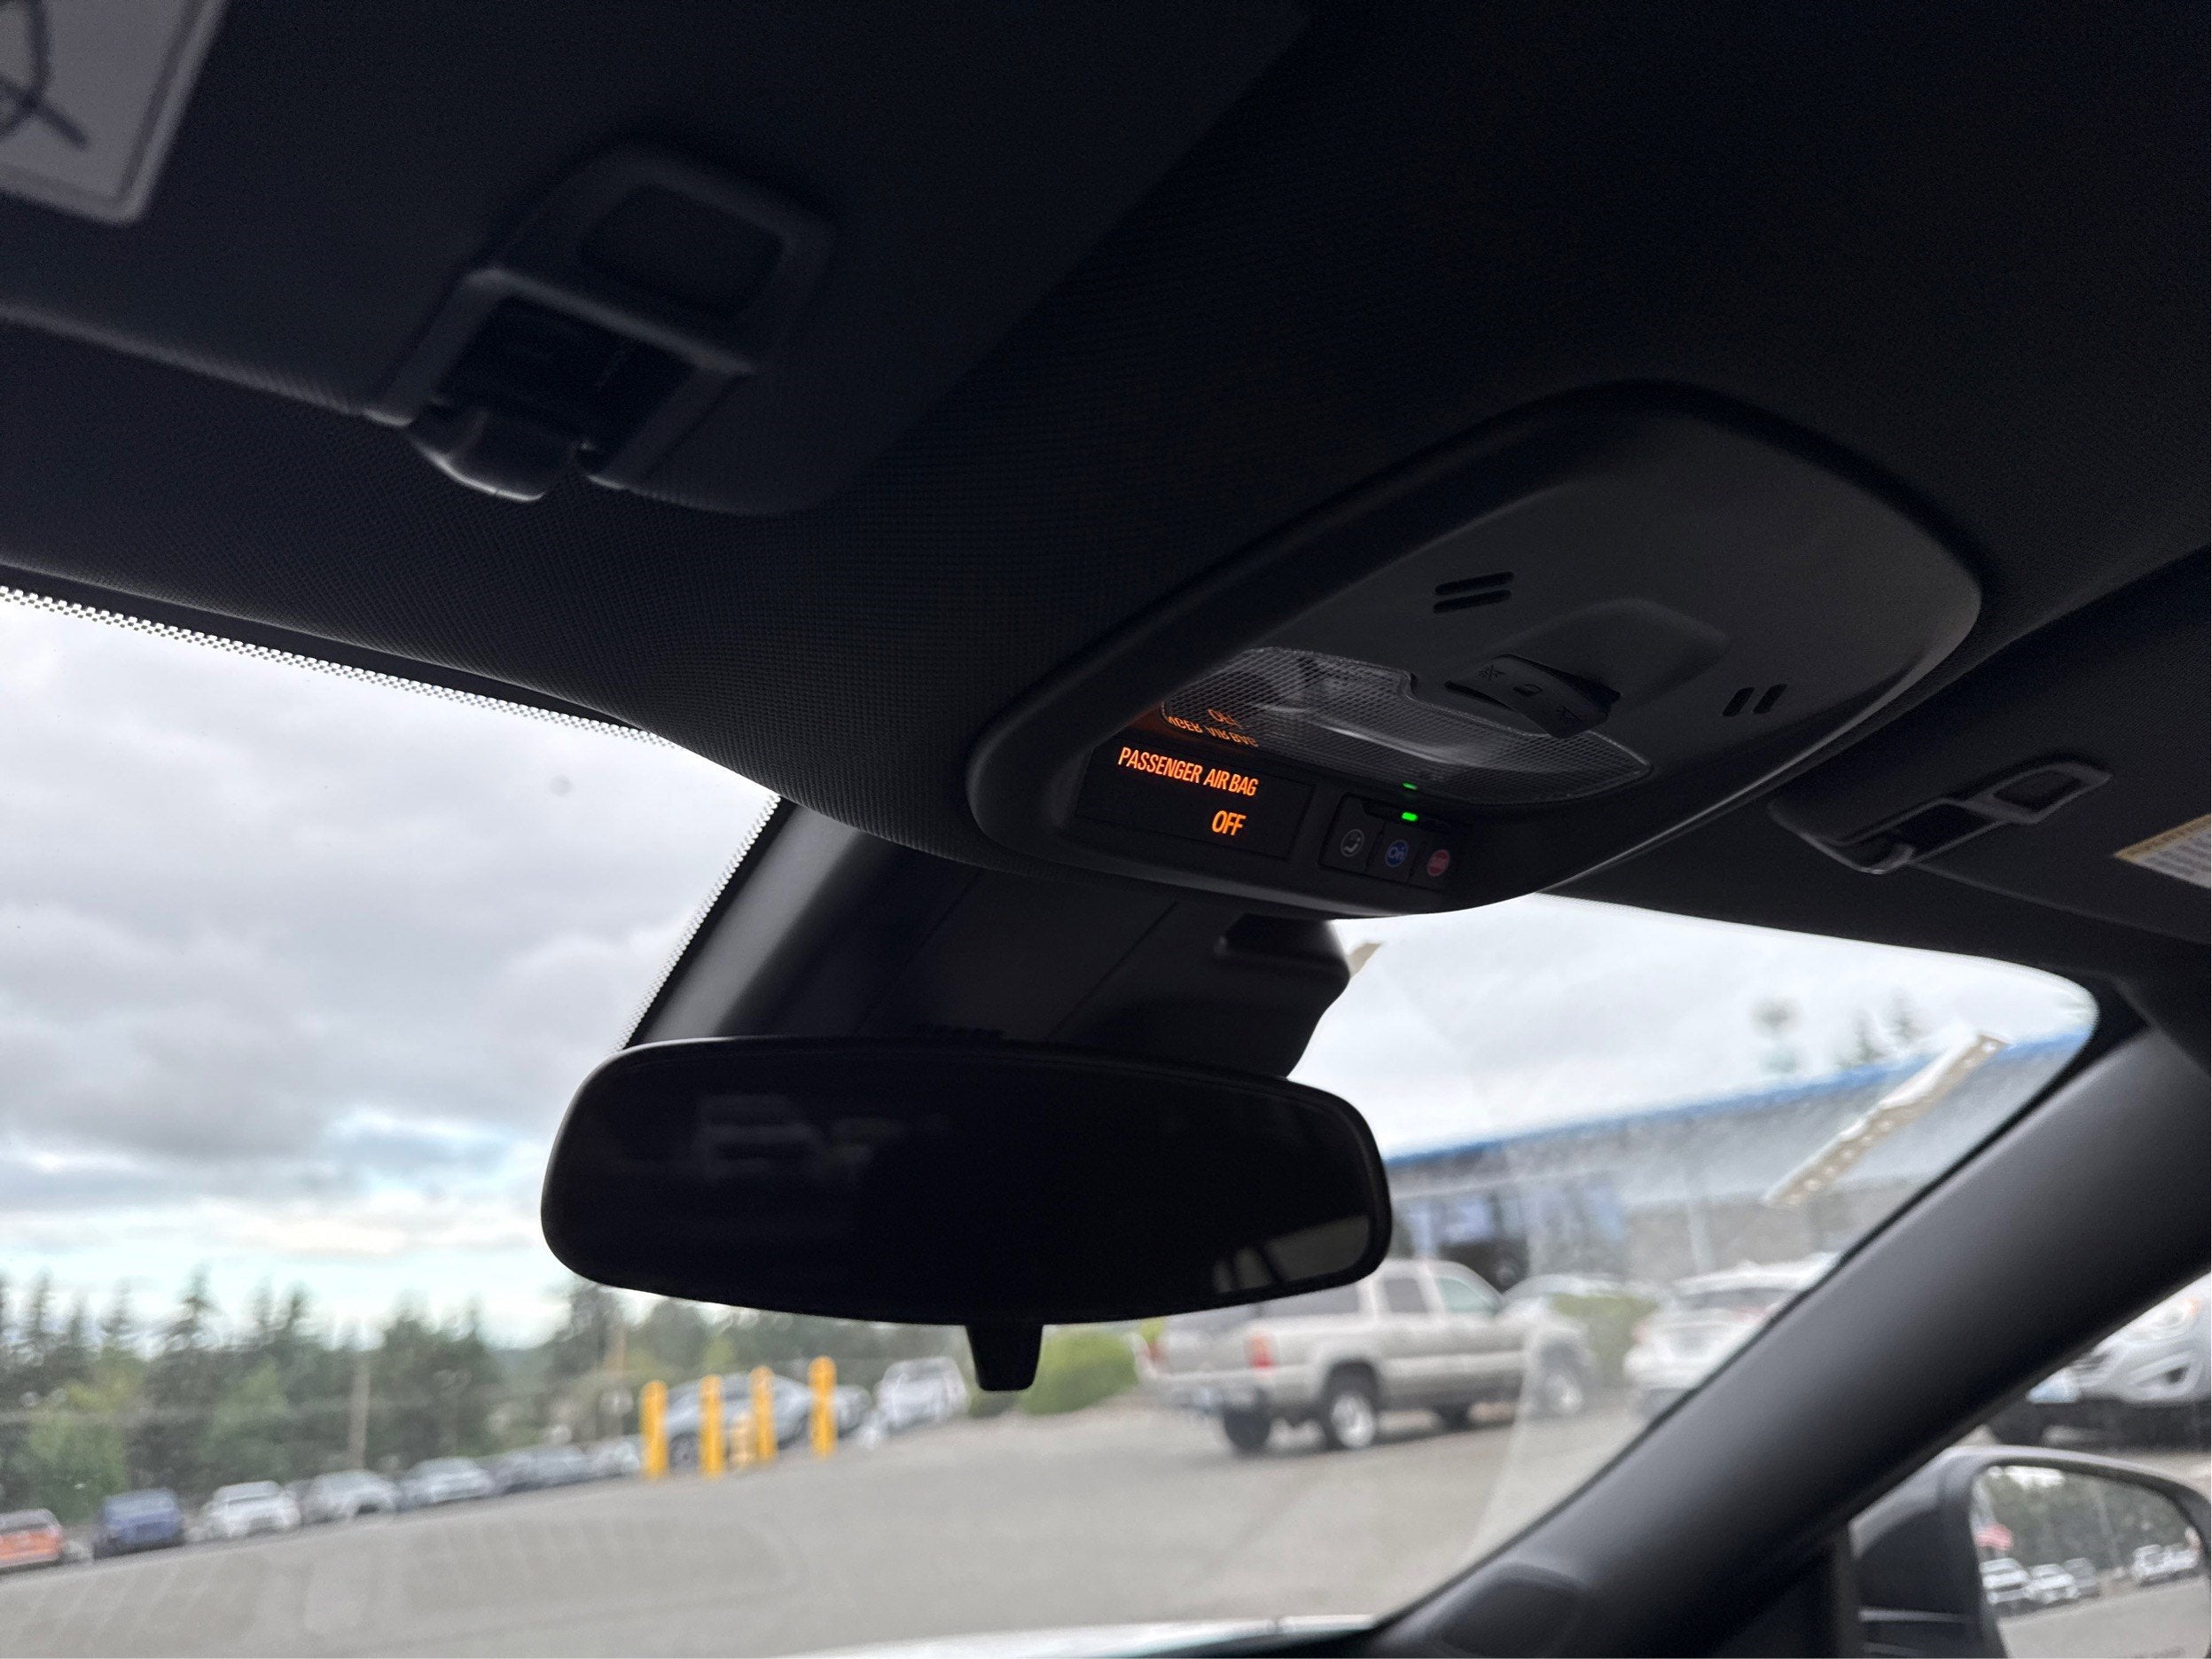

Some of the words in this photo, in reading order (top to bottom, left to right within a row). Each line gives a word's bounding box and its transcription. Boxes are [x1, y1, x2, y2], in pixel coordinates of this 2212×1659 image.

[1118, 747, 1203, 784] PASSENGER
[1203, 769, 1230, 790] AIR
[1228, 774, 1259, 796] BAG
[1211, 810, 1247, 836] OFF
